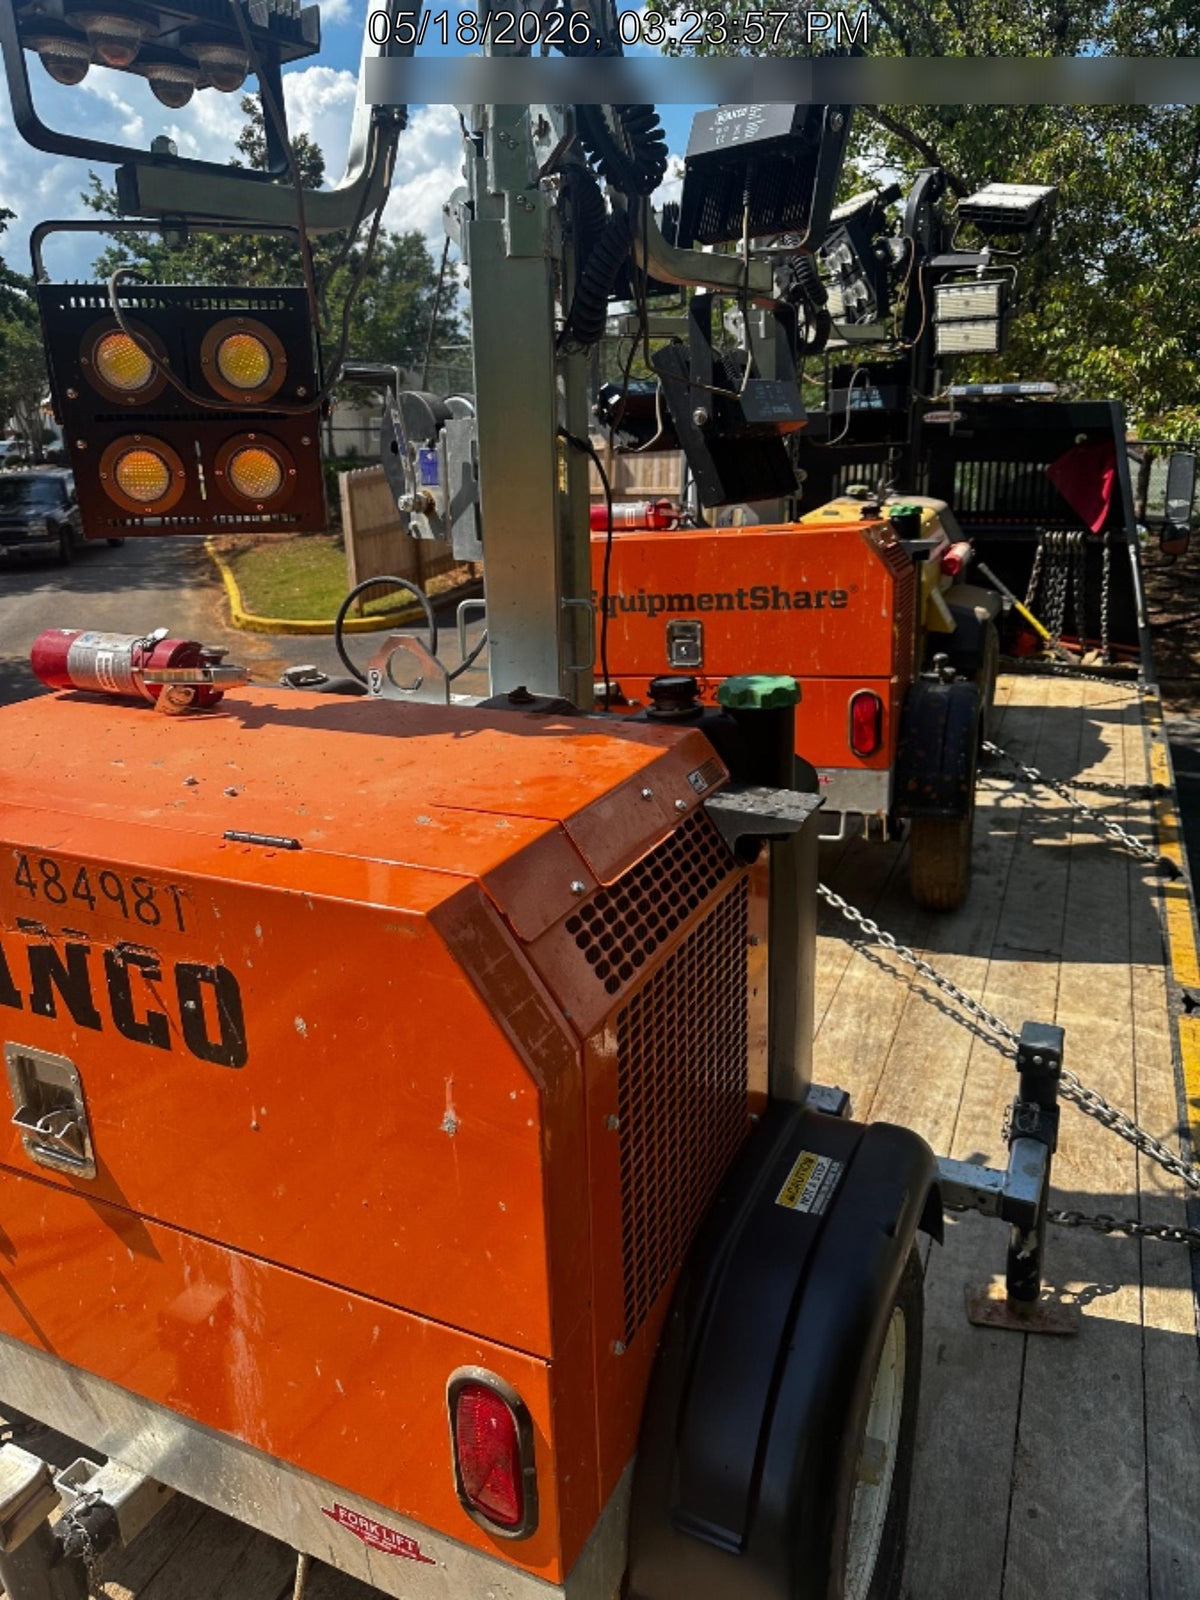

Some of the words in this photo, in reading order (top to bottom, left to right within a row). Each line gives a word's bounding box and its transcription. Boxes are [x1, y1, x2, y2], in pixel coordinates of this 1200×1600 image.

[590, 584, 848, 618] quipmentShare
[14, 854, 186, 933] 484981
[787, 1157, 815, 1194] CAUTION
[800, 1187, 816, 1206] NOT
[811, 1162, 826, 1182] STEP
[339, 1508, 381, 1537] FORK
[382, 1529, 416, 1552] LIFT
